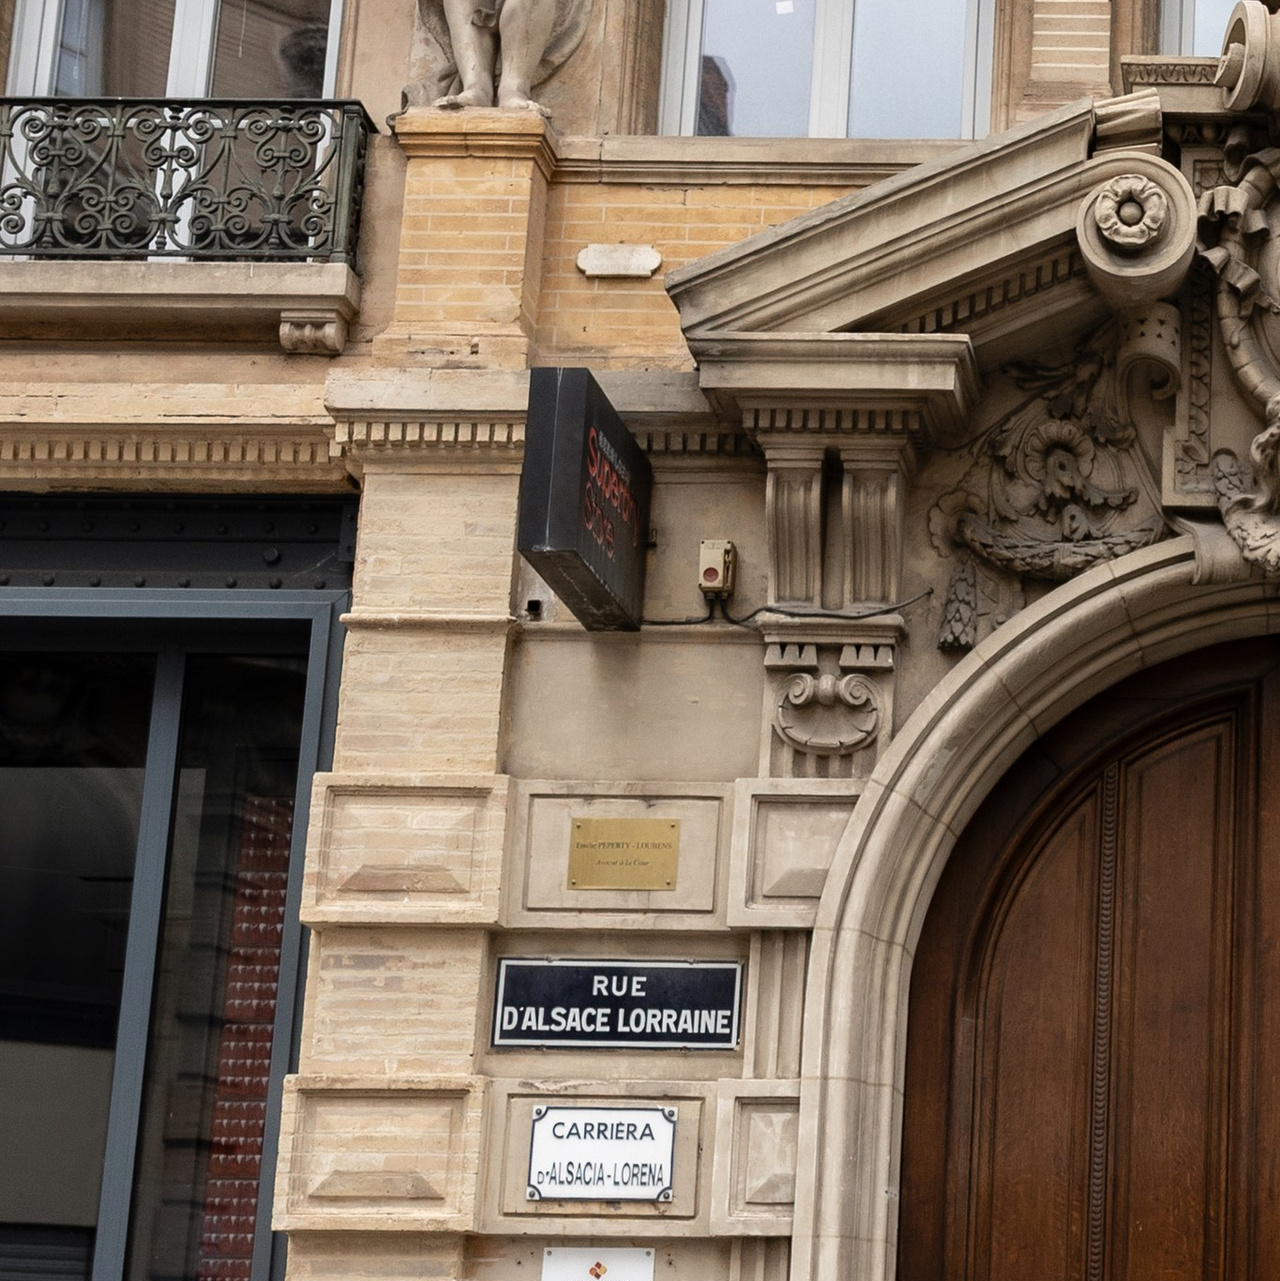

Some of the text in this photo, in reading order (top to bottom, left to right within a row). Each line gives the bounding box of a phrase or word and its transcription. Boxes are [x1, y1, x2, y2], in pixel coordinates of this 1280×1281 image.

[592, 975, 647, 997] RUE
[502, 1006, 731, 1034] D'ALSACE LORRAINE
